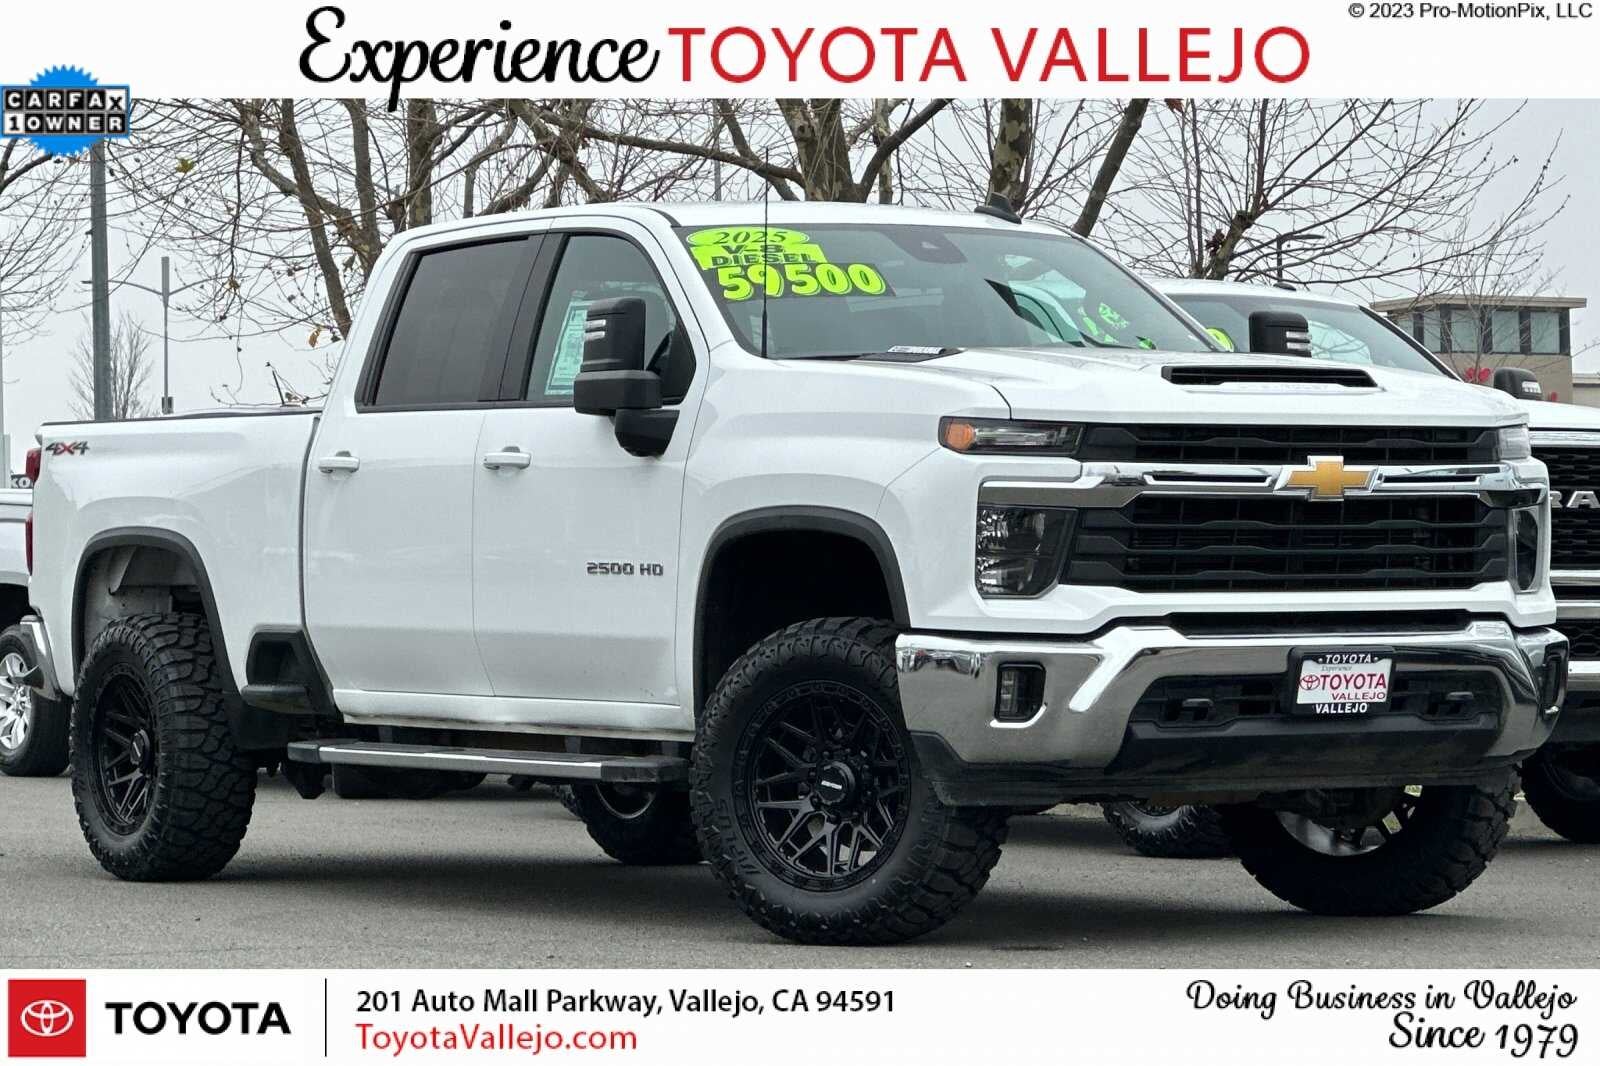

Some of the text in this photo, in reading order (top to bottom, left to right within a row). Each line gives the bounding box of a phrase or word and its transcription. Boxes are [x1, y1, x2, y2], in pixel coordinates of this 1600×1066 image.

[713, 231, 787, 244] 2025
[711, 253, 817, 266] DIESEL
[717, 264, 886, 300] 59500
[586, 562, 664, 577] 2500 HD
[1326, 654, 1372, 664] TOYOTA
[1320, 673, 1387, 691] TOYOTA
[1332, 692, 1386, 701] VALLEJO
[1315, 702, 1368, 714] VALLEJO
